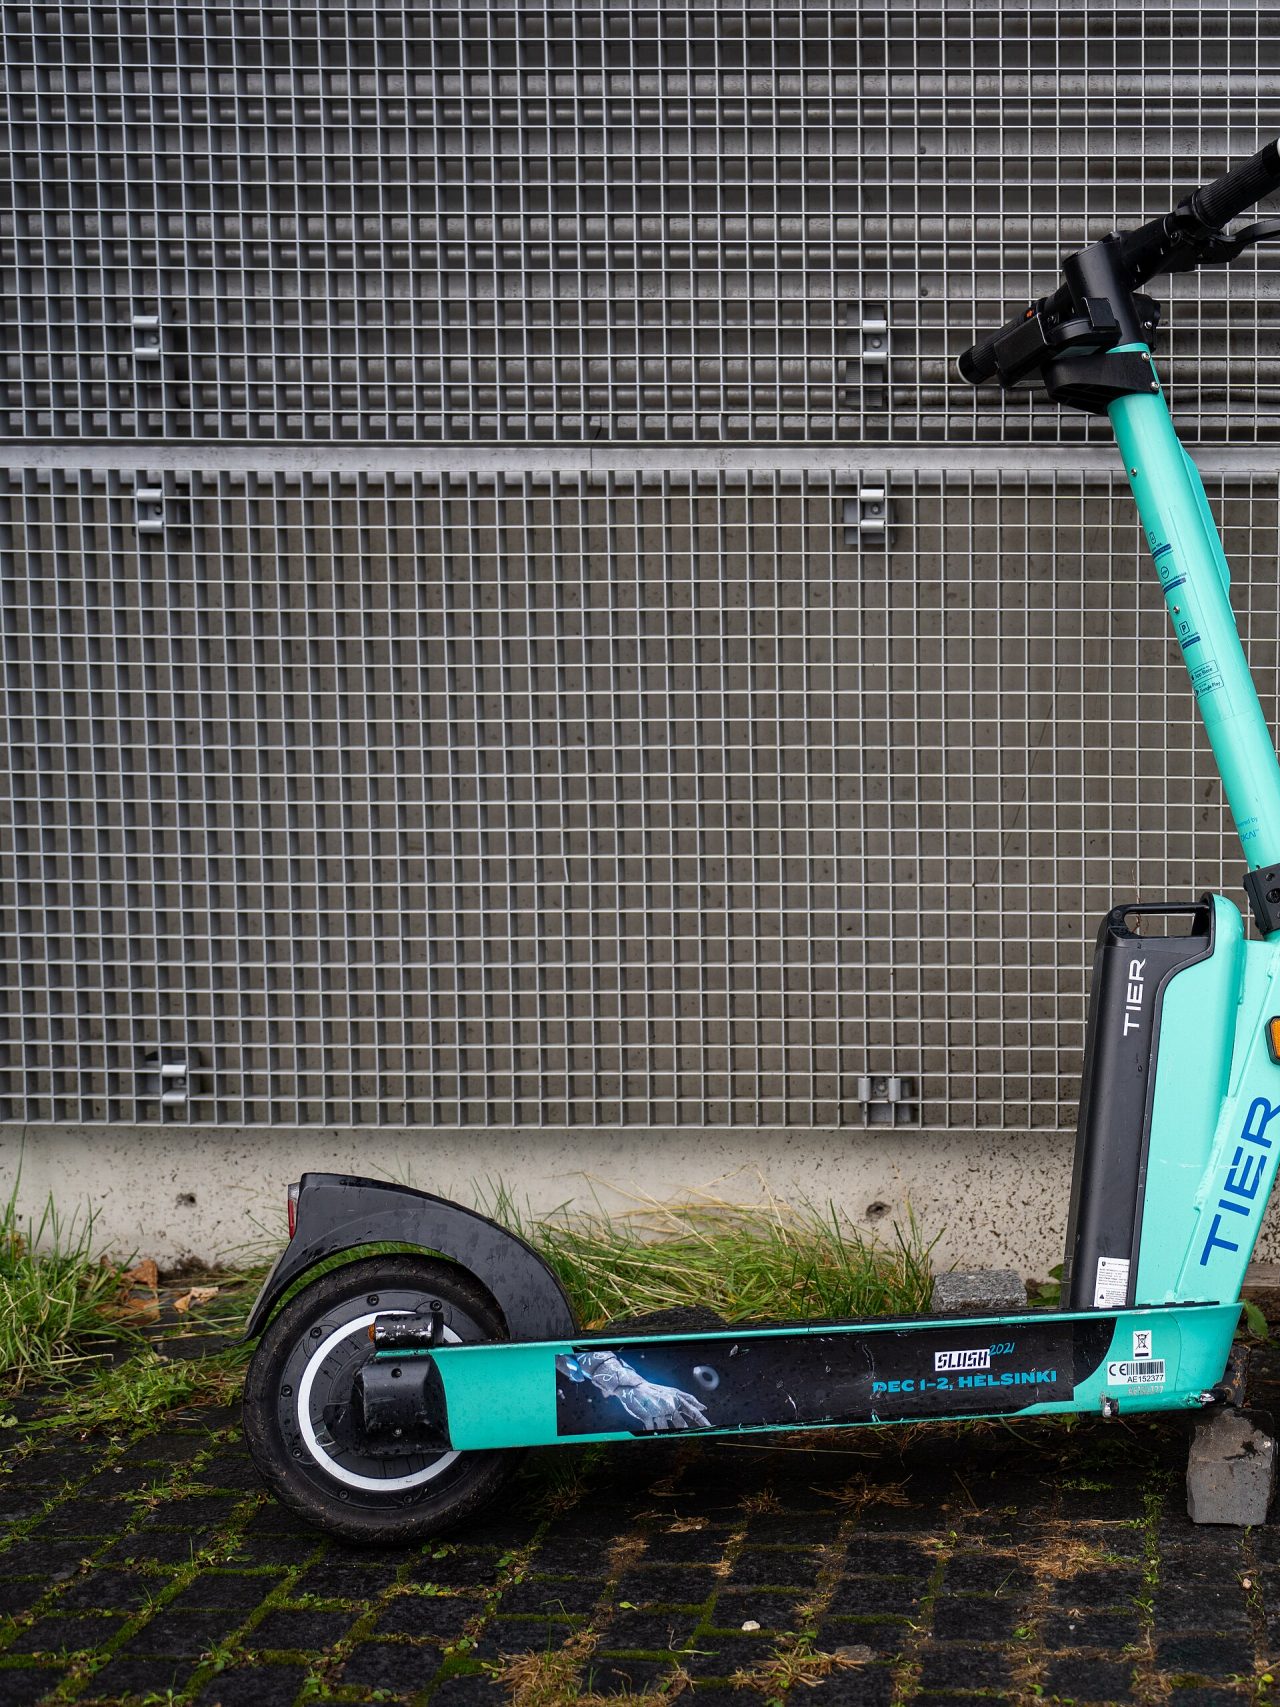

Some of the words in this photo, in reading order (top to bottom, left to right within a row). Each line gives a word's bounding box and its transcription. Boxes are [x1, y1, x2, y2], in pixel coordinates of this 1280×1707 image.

[1199, 684, 1212, 694] Google
[1211, 681, 1221, 689] Play
[1122, 957, 1147, 1037] TIER
[937, 1351, 989, 1369] SLUSH
[988, 1342, 1016, 1357] 2021
[872, 1379, 915, 1394] DEC
[958, 1370, 1057, 1388] HELSINKI
[1127, 1374, 1164, 1384] AE152377
